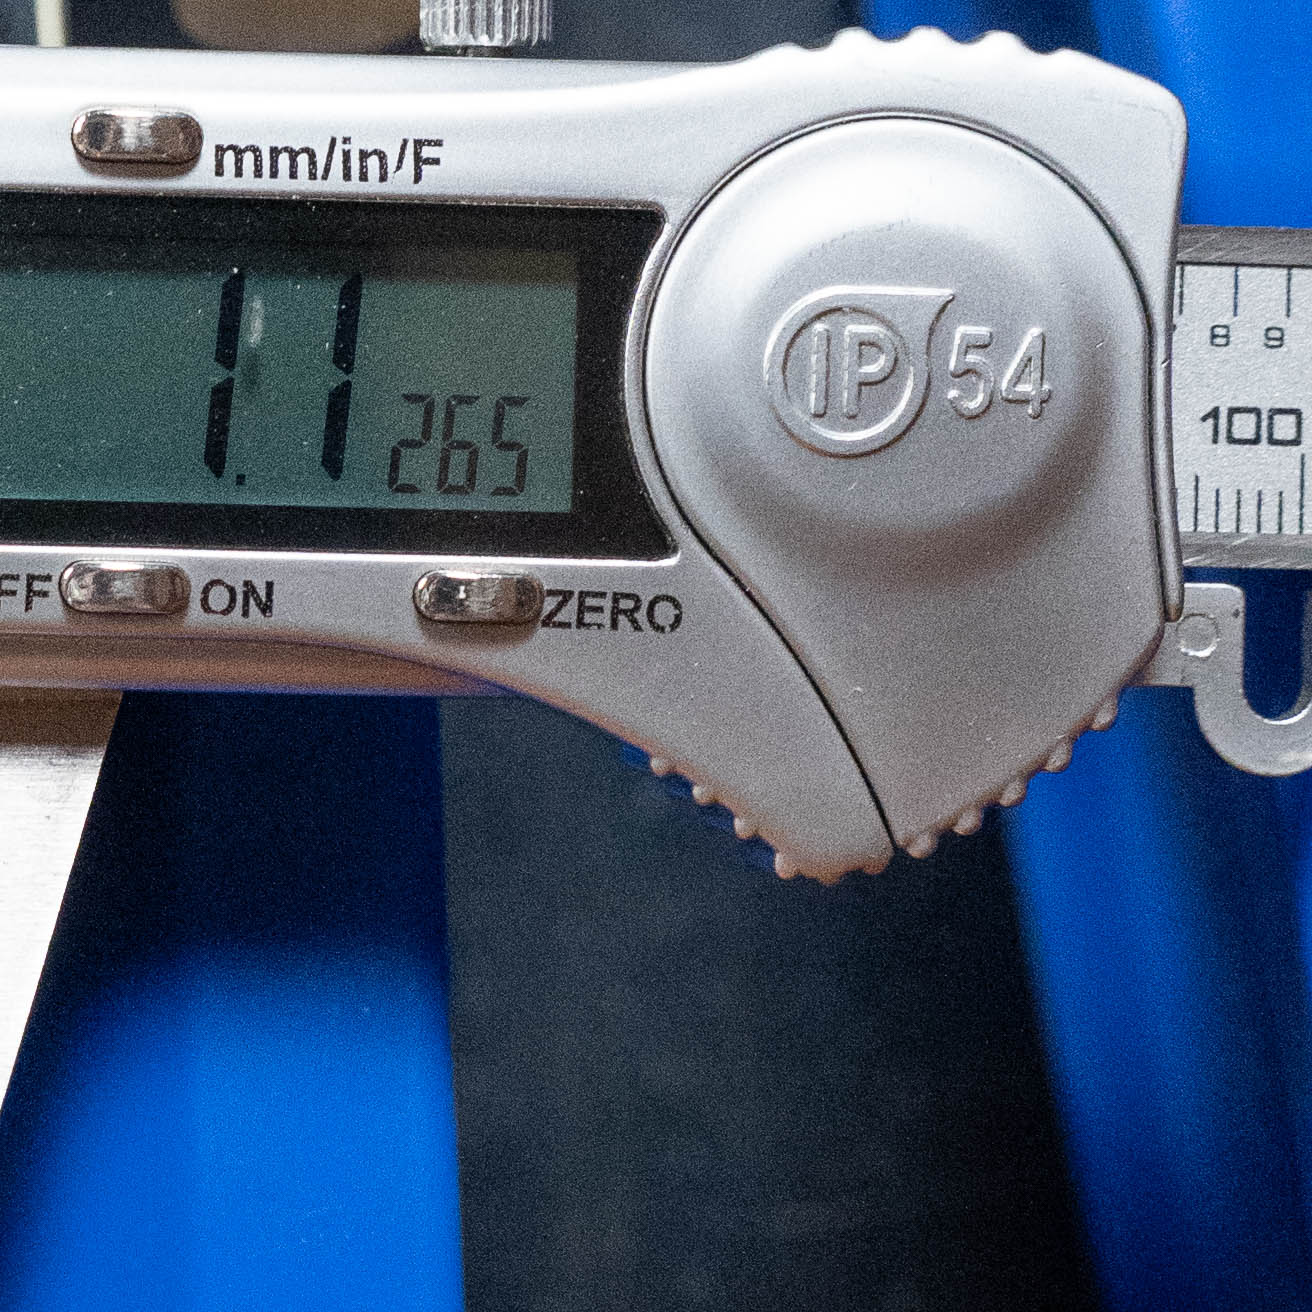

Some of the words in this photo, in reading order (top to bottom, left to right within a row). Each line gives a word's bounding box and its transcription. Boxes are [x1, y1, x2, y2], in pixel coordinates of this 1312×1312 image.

[213, 136, 444, 185] mm/in/F
[1210, 324, 1230, 347] 8
[1264, 326, 1285, 349] 9
[810, 322, 898, 418] IP
[946, 324, 1051, 420] 54
[1200, 406, 1303, 446] 100
[200, 578, 274, 619] ON
[541, 588, 684, 633] ZERO
